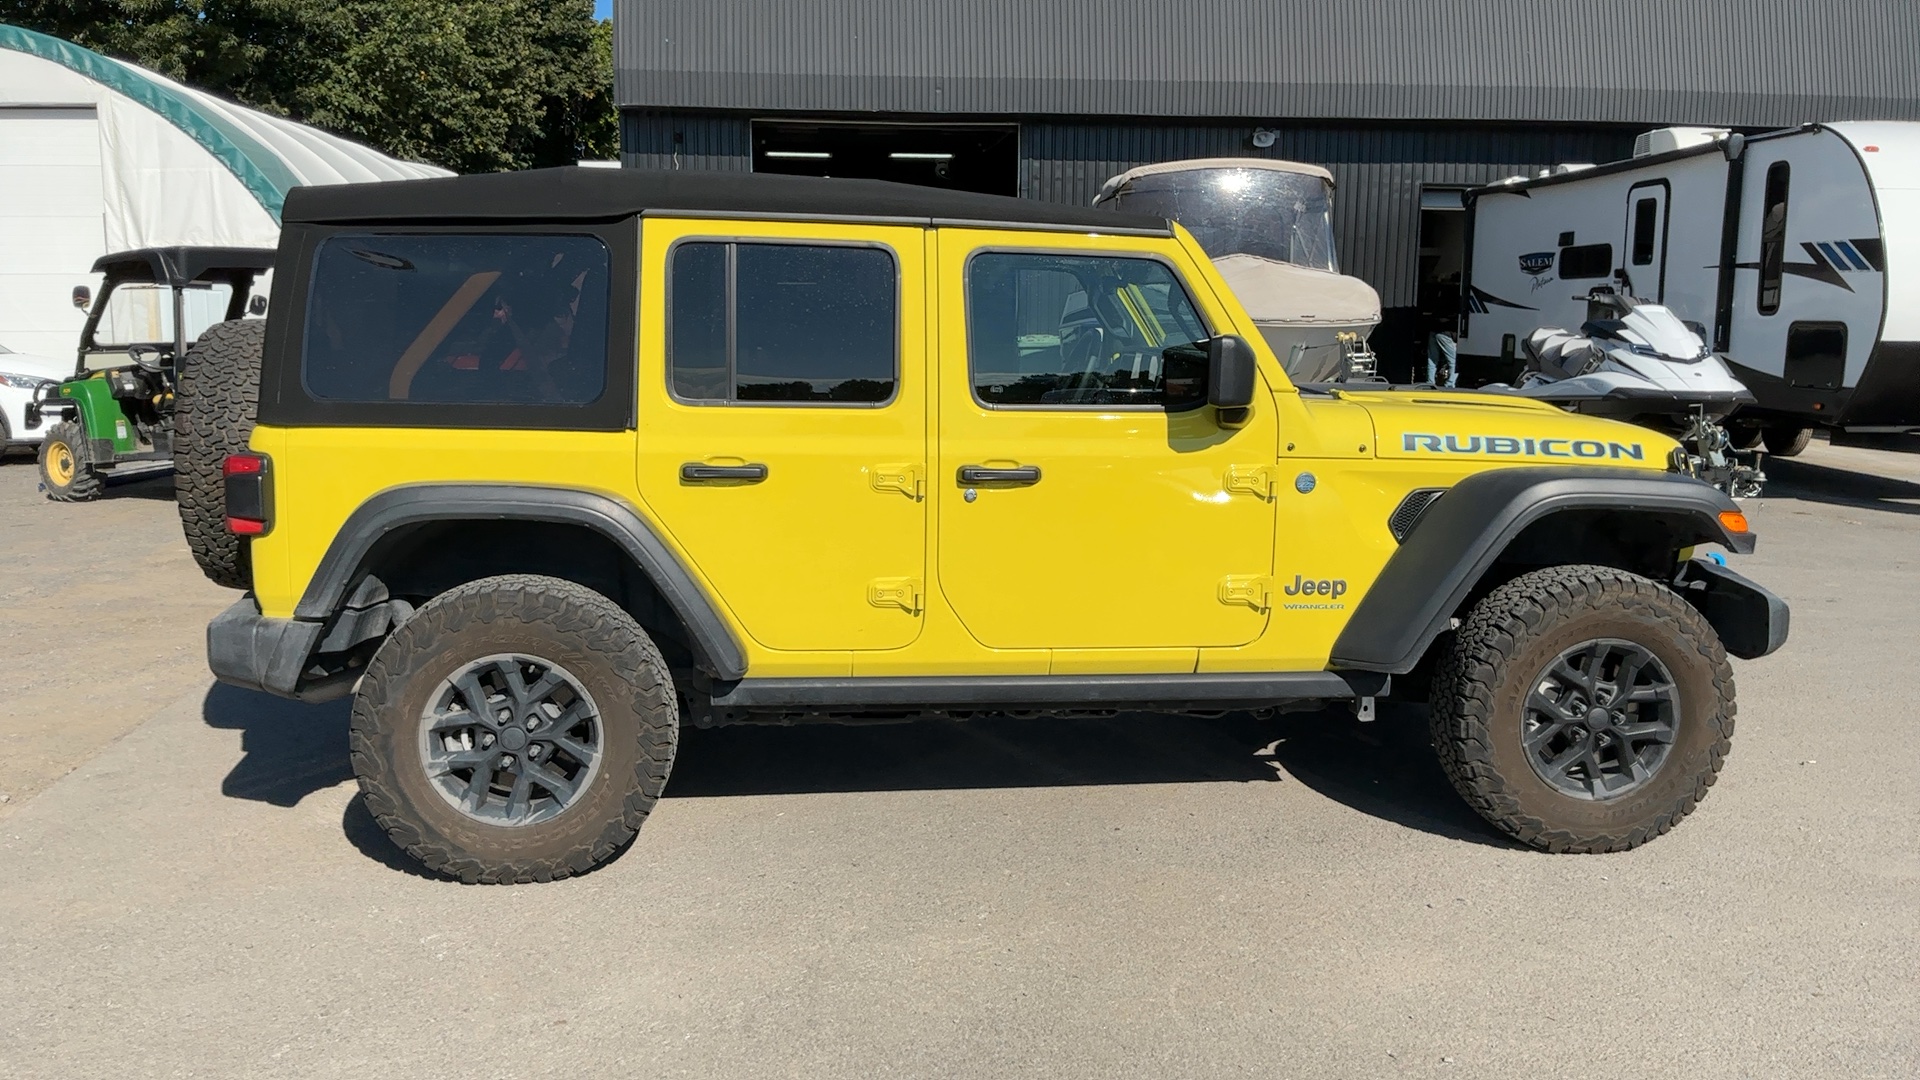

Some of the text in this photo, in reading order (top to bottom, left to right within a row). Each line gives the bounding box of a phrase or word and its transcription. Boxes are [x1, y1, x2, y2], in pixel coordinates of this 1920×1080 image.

[1520, 257, 1553, 268] SALEM
[1403, 433, 1643, 460] RUBICON
[1284, 574, 1347, 599] Jeep
